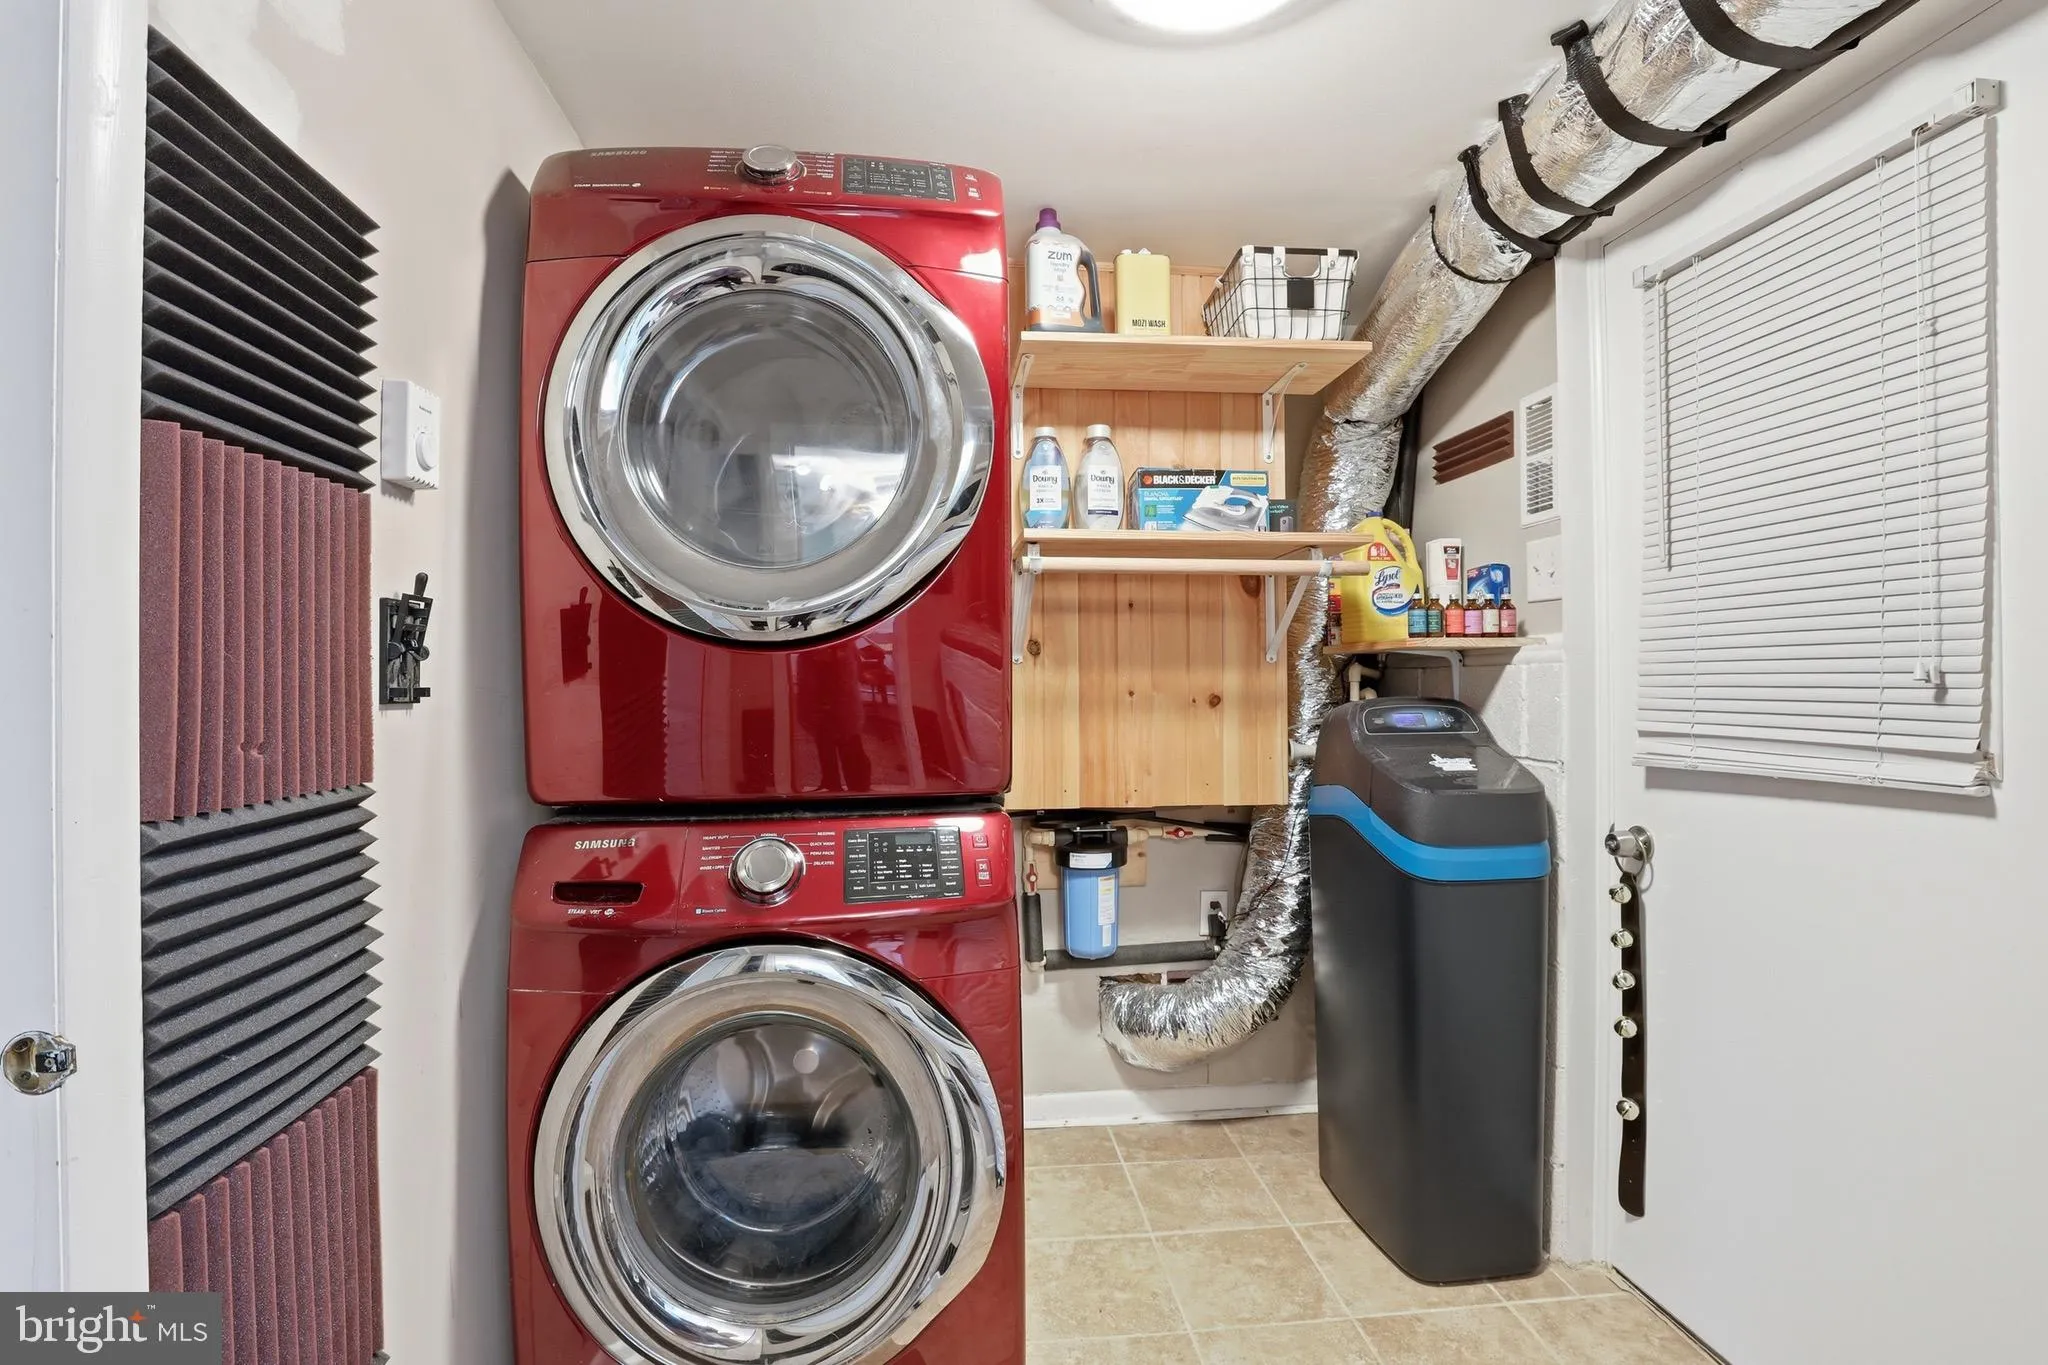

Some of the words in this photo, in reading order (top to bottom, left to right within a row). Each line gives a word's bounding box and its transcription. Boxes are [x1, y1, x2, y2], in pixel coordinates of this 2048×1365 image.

[1132, 319, 1147, 328] MOZI
[1148, 320, 1167, 328] WASH
[1032, 474, 1058, 485] Downy
[1090, 474, 1115, 485] Downy
[1153, 475, 1216, 485] BLACK&DECKER
[1374, 569, 1399, 586] Lysol
[574, 838, 636, 850] SAMSUNG
